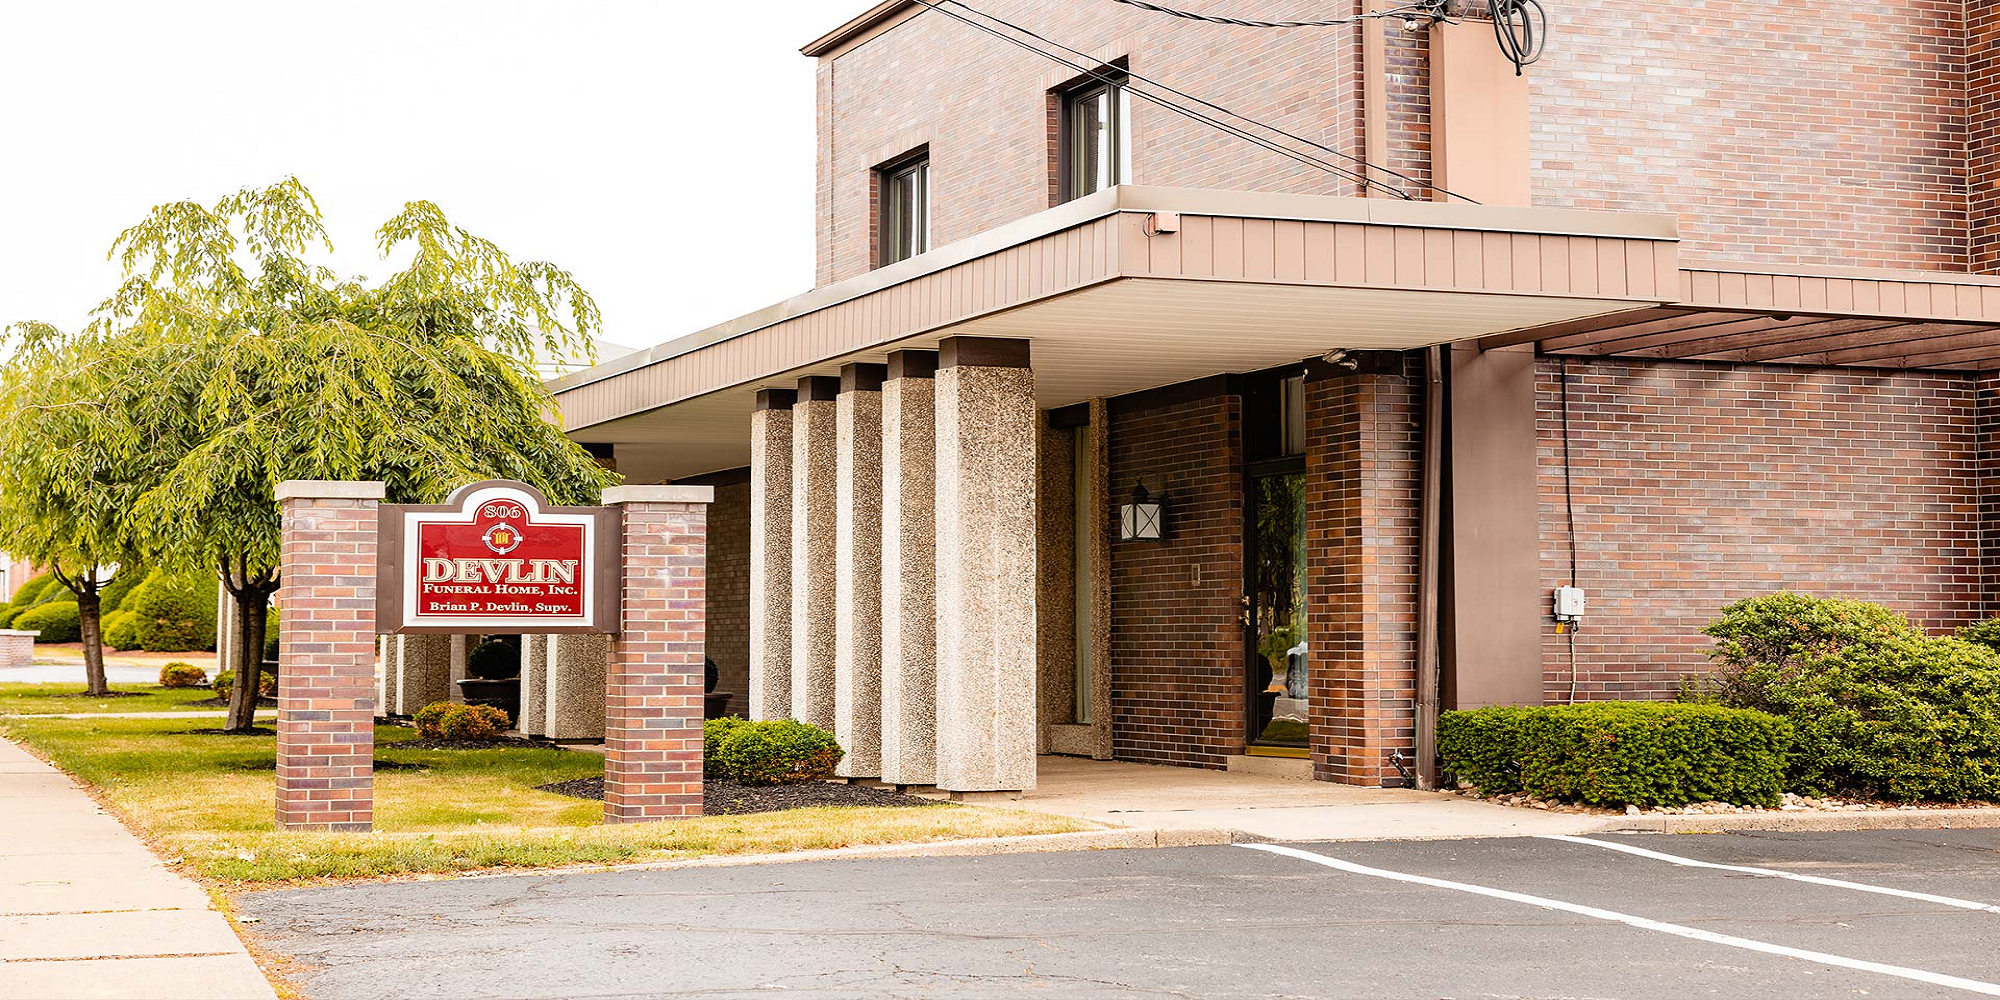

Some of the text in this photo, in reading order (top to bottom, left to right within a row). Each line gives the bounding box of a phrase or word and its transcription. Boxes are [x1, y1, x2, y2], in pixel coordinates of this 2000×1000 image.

[484, 505, 521, 519] 806
[423, 557, 578, 584] DEVLIN
[429, 602, 572, 614] Brian P. Devlin, Supv.
